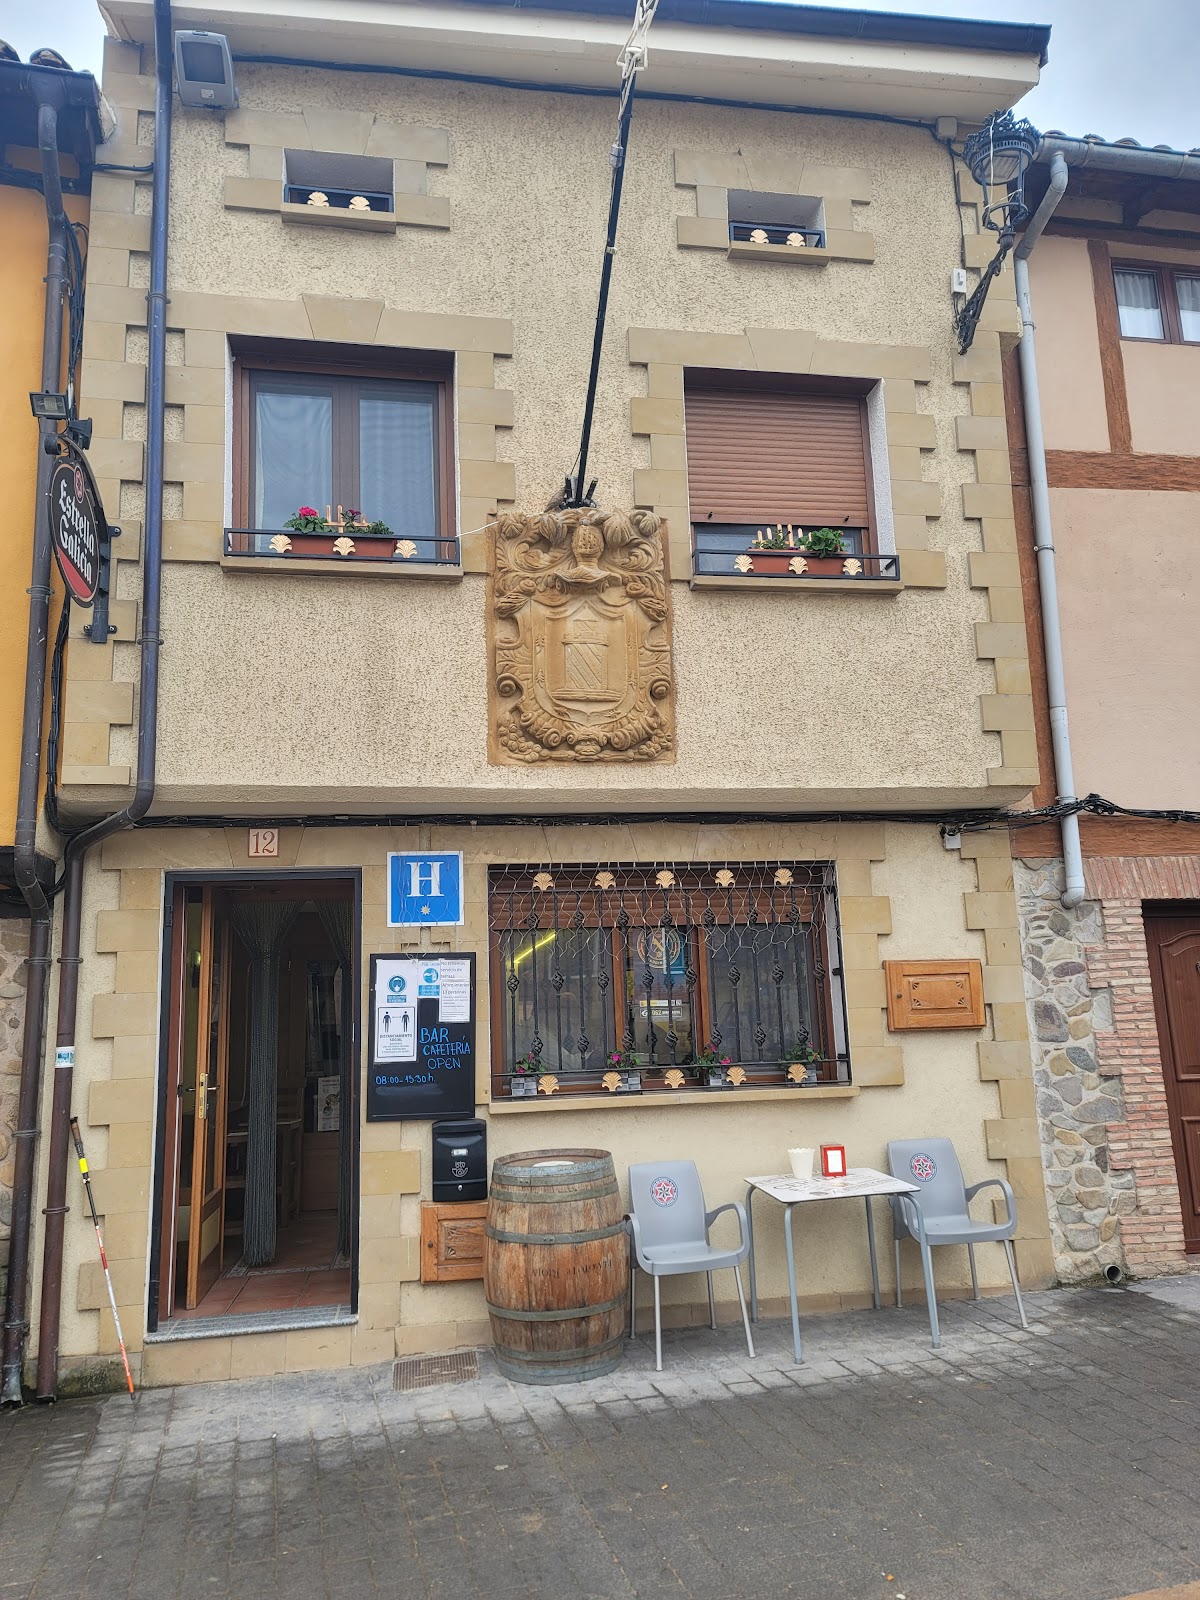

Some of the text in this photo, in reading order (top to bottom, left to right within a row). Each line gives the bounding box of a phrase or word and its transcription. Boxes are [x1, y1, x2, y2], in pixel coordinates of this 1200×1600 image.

[59, 479, 95, 557] Estrella
[59, 516, 92, 585] Galicia
[252, 830, 275, 854] 12
[406, 861, 445, 897] H
[419, 1027, 449, 1044] BAR
[422, 1035, 471, 1056] CAFETERÍA
[427, 1057, 462, 1070] OPEN
